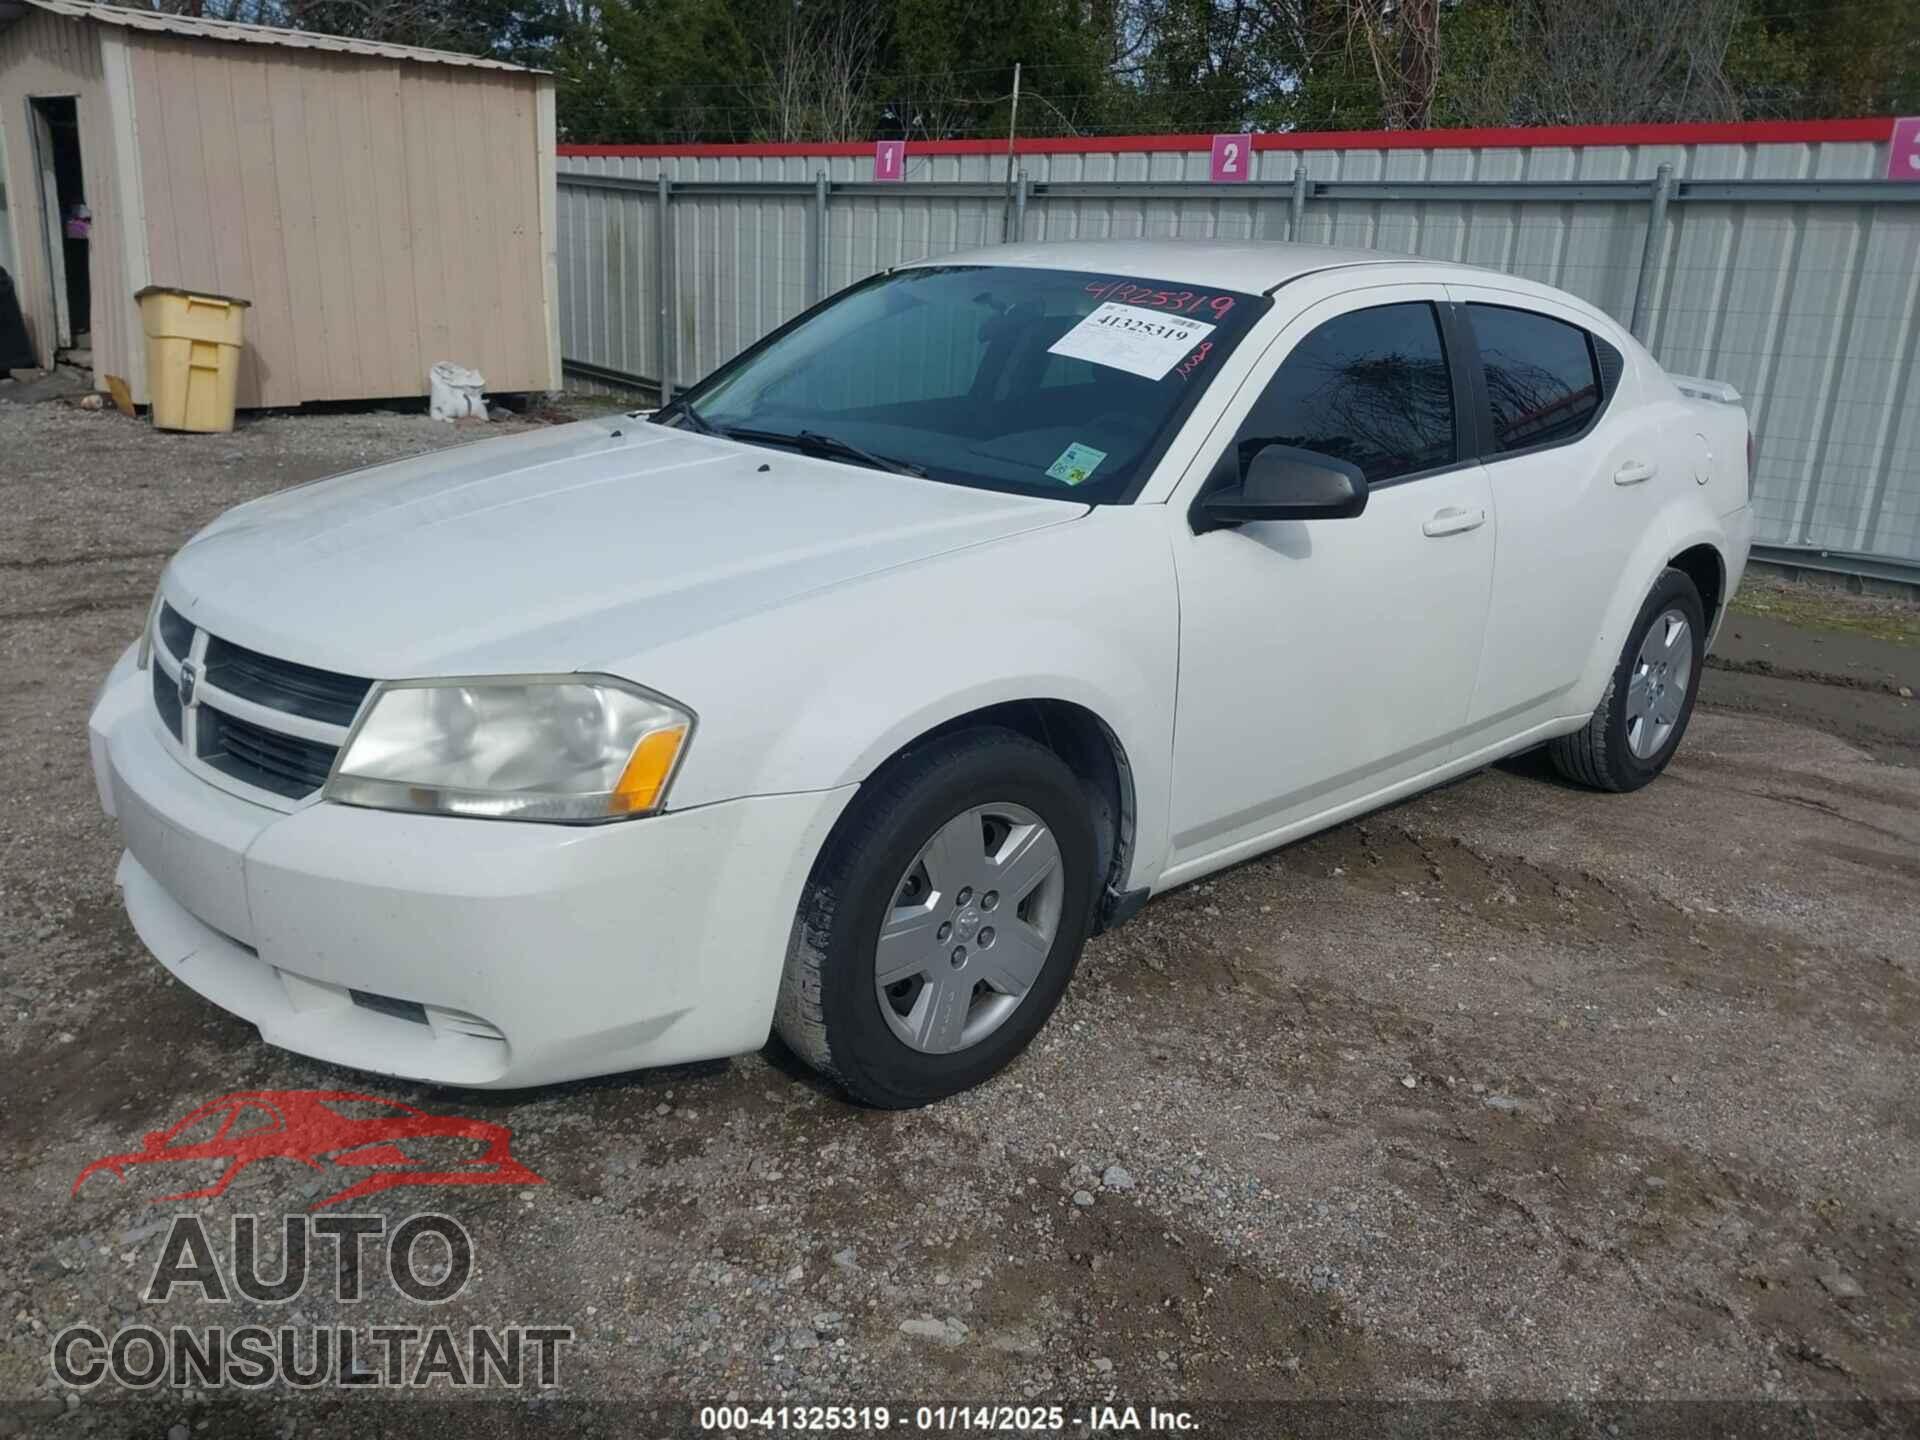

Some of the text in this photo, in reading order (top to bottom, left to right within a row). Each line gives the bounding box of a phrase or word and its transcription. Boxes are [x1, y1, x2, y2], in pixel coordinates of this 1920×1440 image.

[884, 147, 894, 172] 1
[1222, 143, 1238, 172] 2
[1085, 281, 1235, 319] 41325319
[1097, 314, 1189, 341] 41325319
